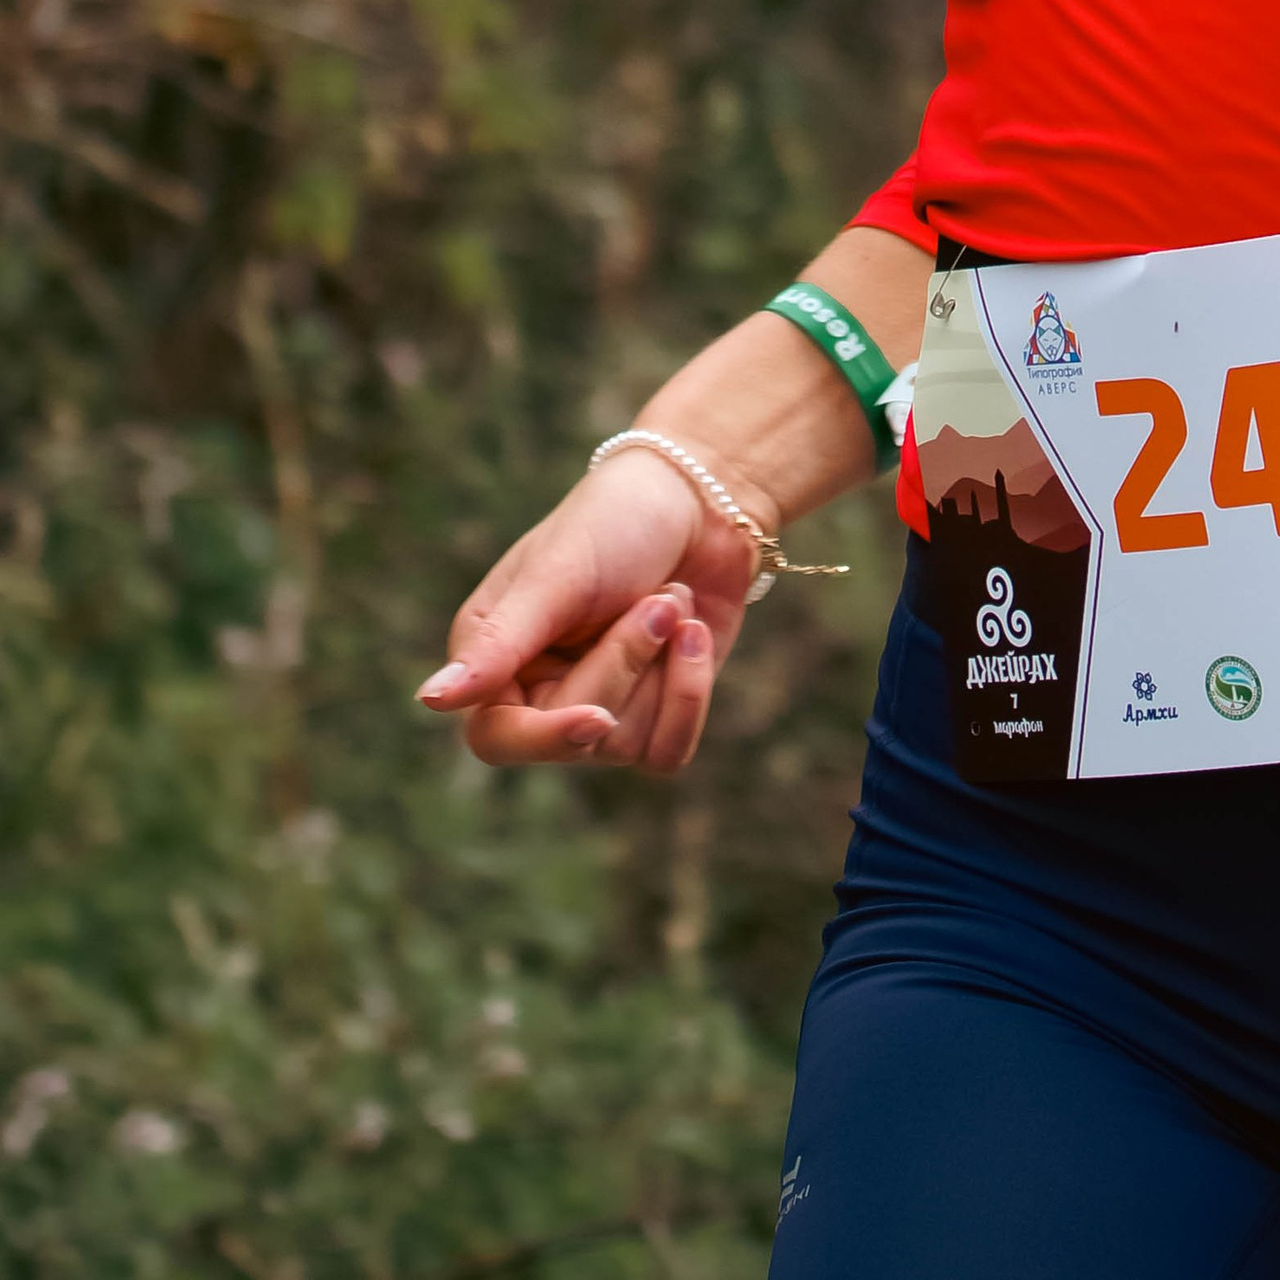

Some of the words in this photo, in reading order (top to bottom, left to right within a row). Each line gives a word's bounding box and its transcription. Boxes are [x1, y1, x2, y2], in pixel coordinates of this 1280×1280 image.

[1027, 366, 1083, 380] Типография
[1038, 381, 1077, 396] АВЕРС
[966, 650, 1059, 690] ДЖЕЙРАХ
[1122, 703, 1179, 727] Армхи
[993, 717, 1044, 739] марафон
